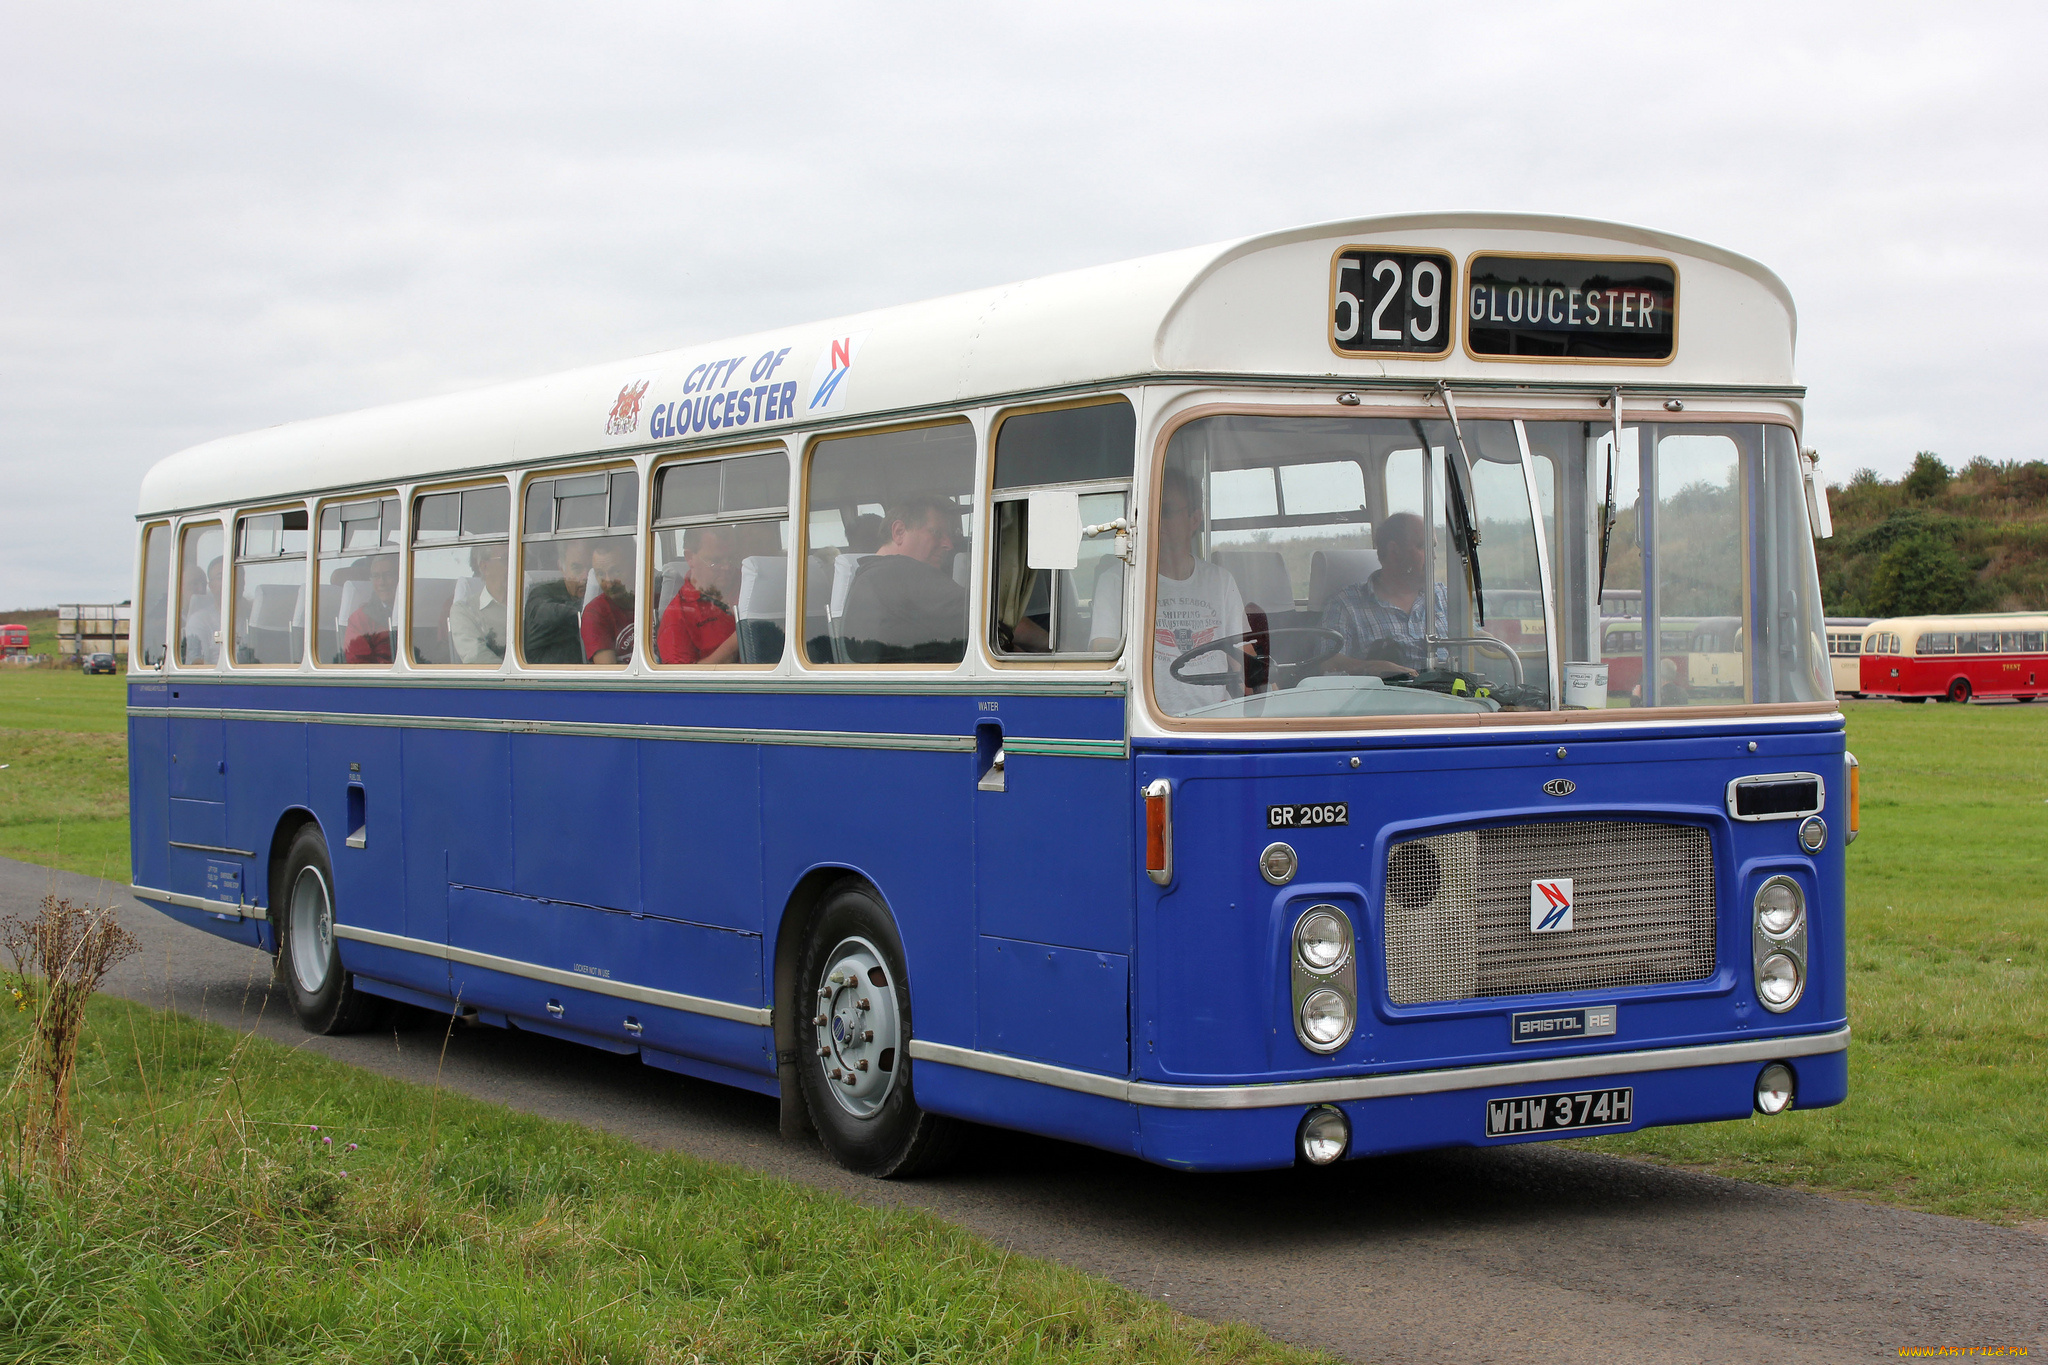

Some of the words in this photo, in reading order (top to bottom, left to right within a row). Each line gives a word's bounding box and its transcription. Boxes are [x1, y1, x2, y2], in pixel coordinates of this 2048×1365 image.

[1334, 259, 1442, 342] 529
[1470, 284, 1655, 329] GLOUCESTER
[683, 356, 747, 395] CITY
[750, 347, 792, 383] OF
[650, 380, 797, 440] GLOUCESTER
[1163, 611, 1200, 619] SHIPPING
[978, 702, 999, 711] WATER
[1547, 780, 1573, 794] ECW
[1271, 807, 1294, 826] GR
[1300, 805, 1347, 824] 2062
[1519, 1017, 1582, 1034] BRISTOL
[1589, 1013, 1611, 1028] RE
[1490, 1098, 1546, 1134] WHW
[1555, 1088, 1631, 1126] 374H
